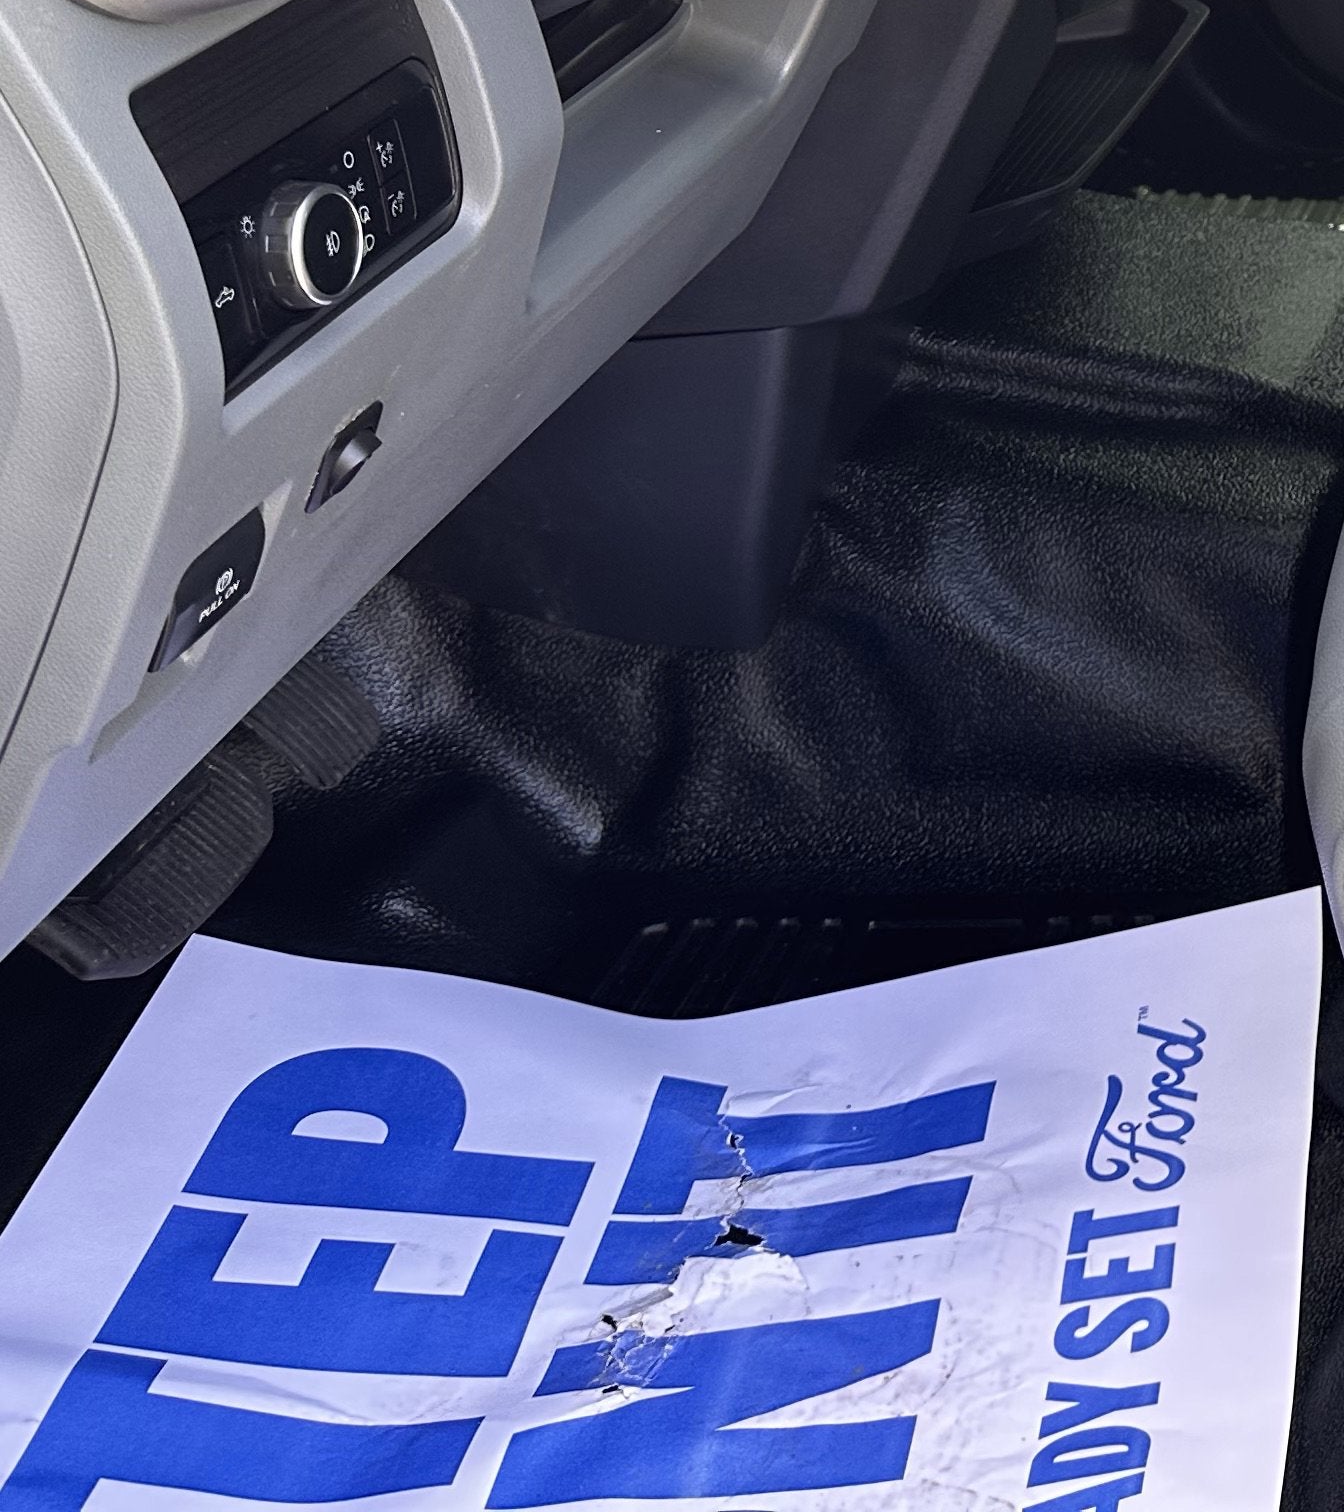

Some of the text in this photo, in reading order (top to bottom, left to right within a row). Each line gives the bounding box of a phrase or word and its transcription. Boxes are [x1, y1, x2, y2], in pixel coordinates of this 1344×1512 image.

[199, 580, 240, 623] PULL ON
[1085, 1018, 1207, 1192] Ford
[1053, 1205, 1180, 1361] SET
